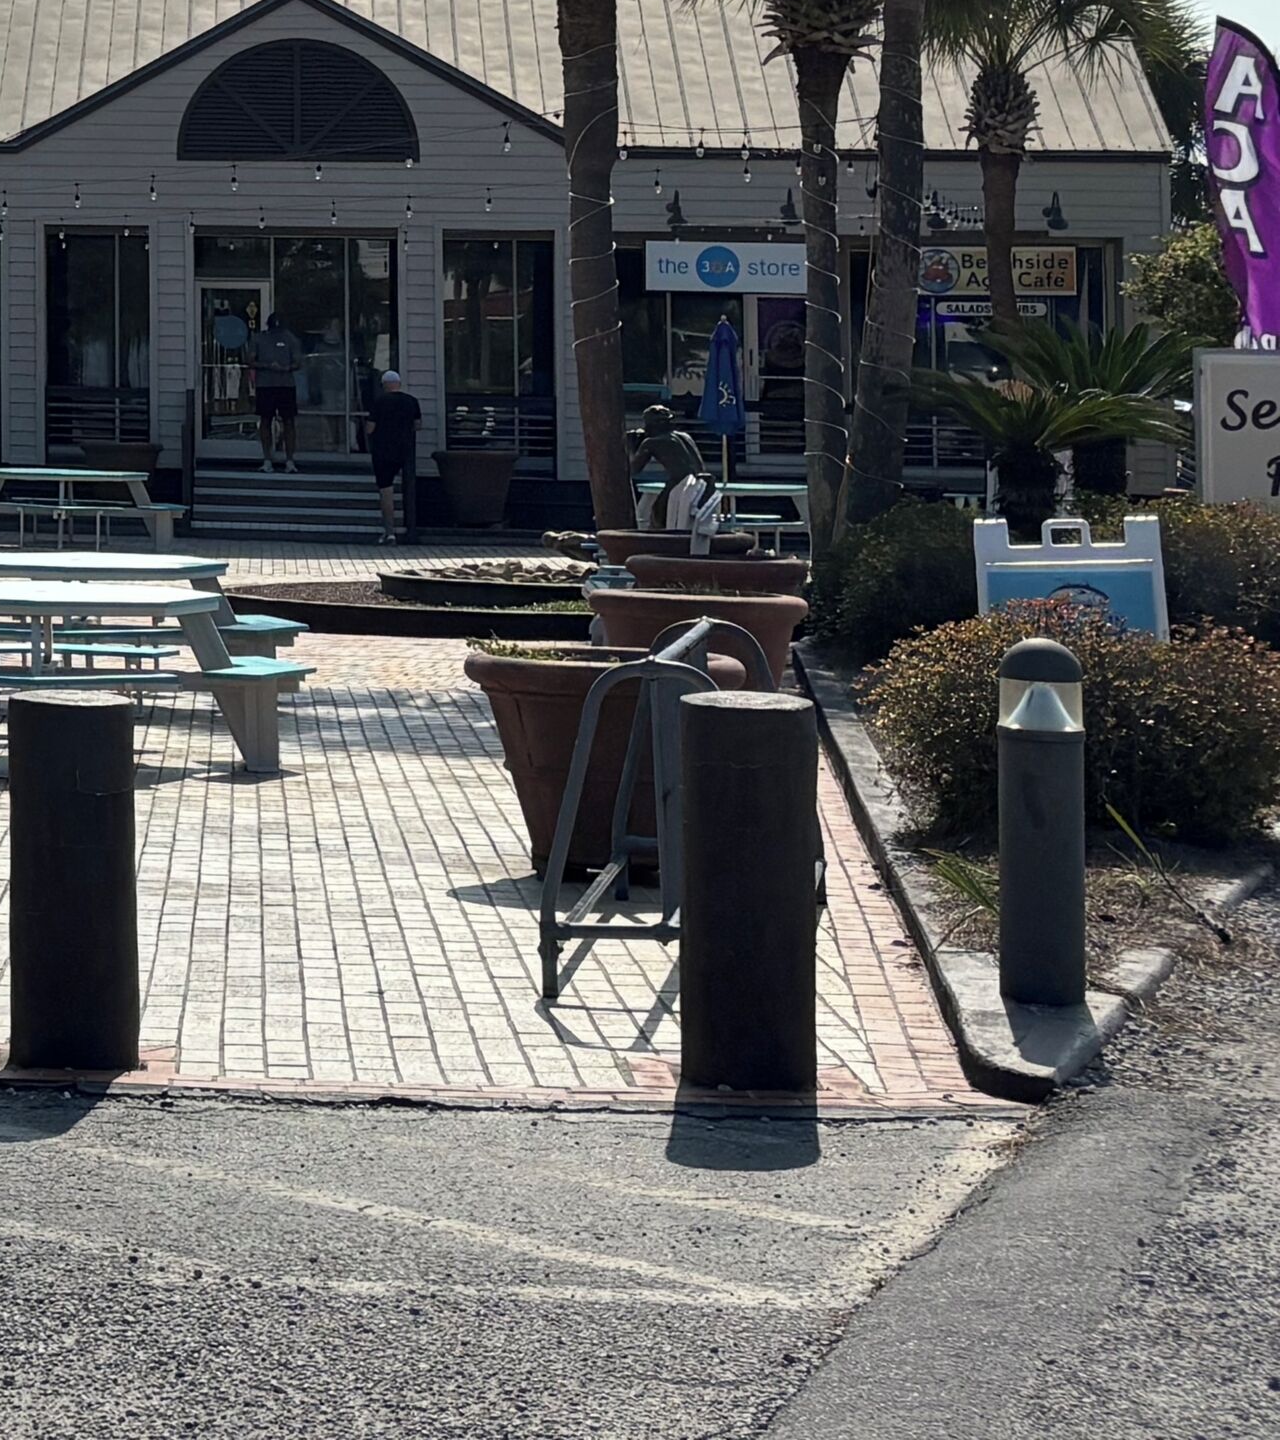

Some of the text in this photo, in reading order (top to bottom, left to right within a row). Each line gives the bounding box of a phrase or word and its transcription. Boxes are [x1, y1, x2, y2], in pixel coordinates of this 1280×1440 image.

[657, 257, 689, 274] the
[747, 261, 800, 276] store
[946, 304, 991, 314] SALADS
